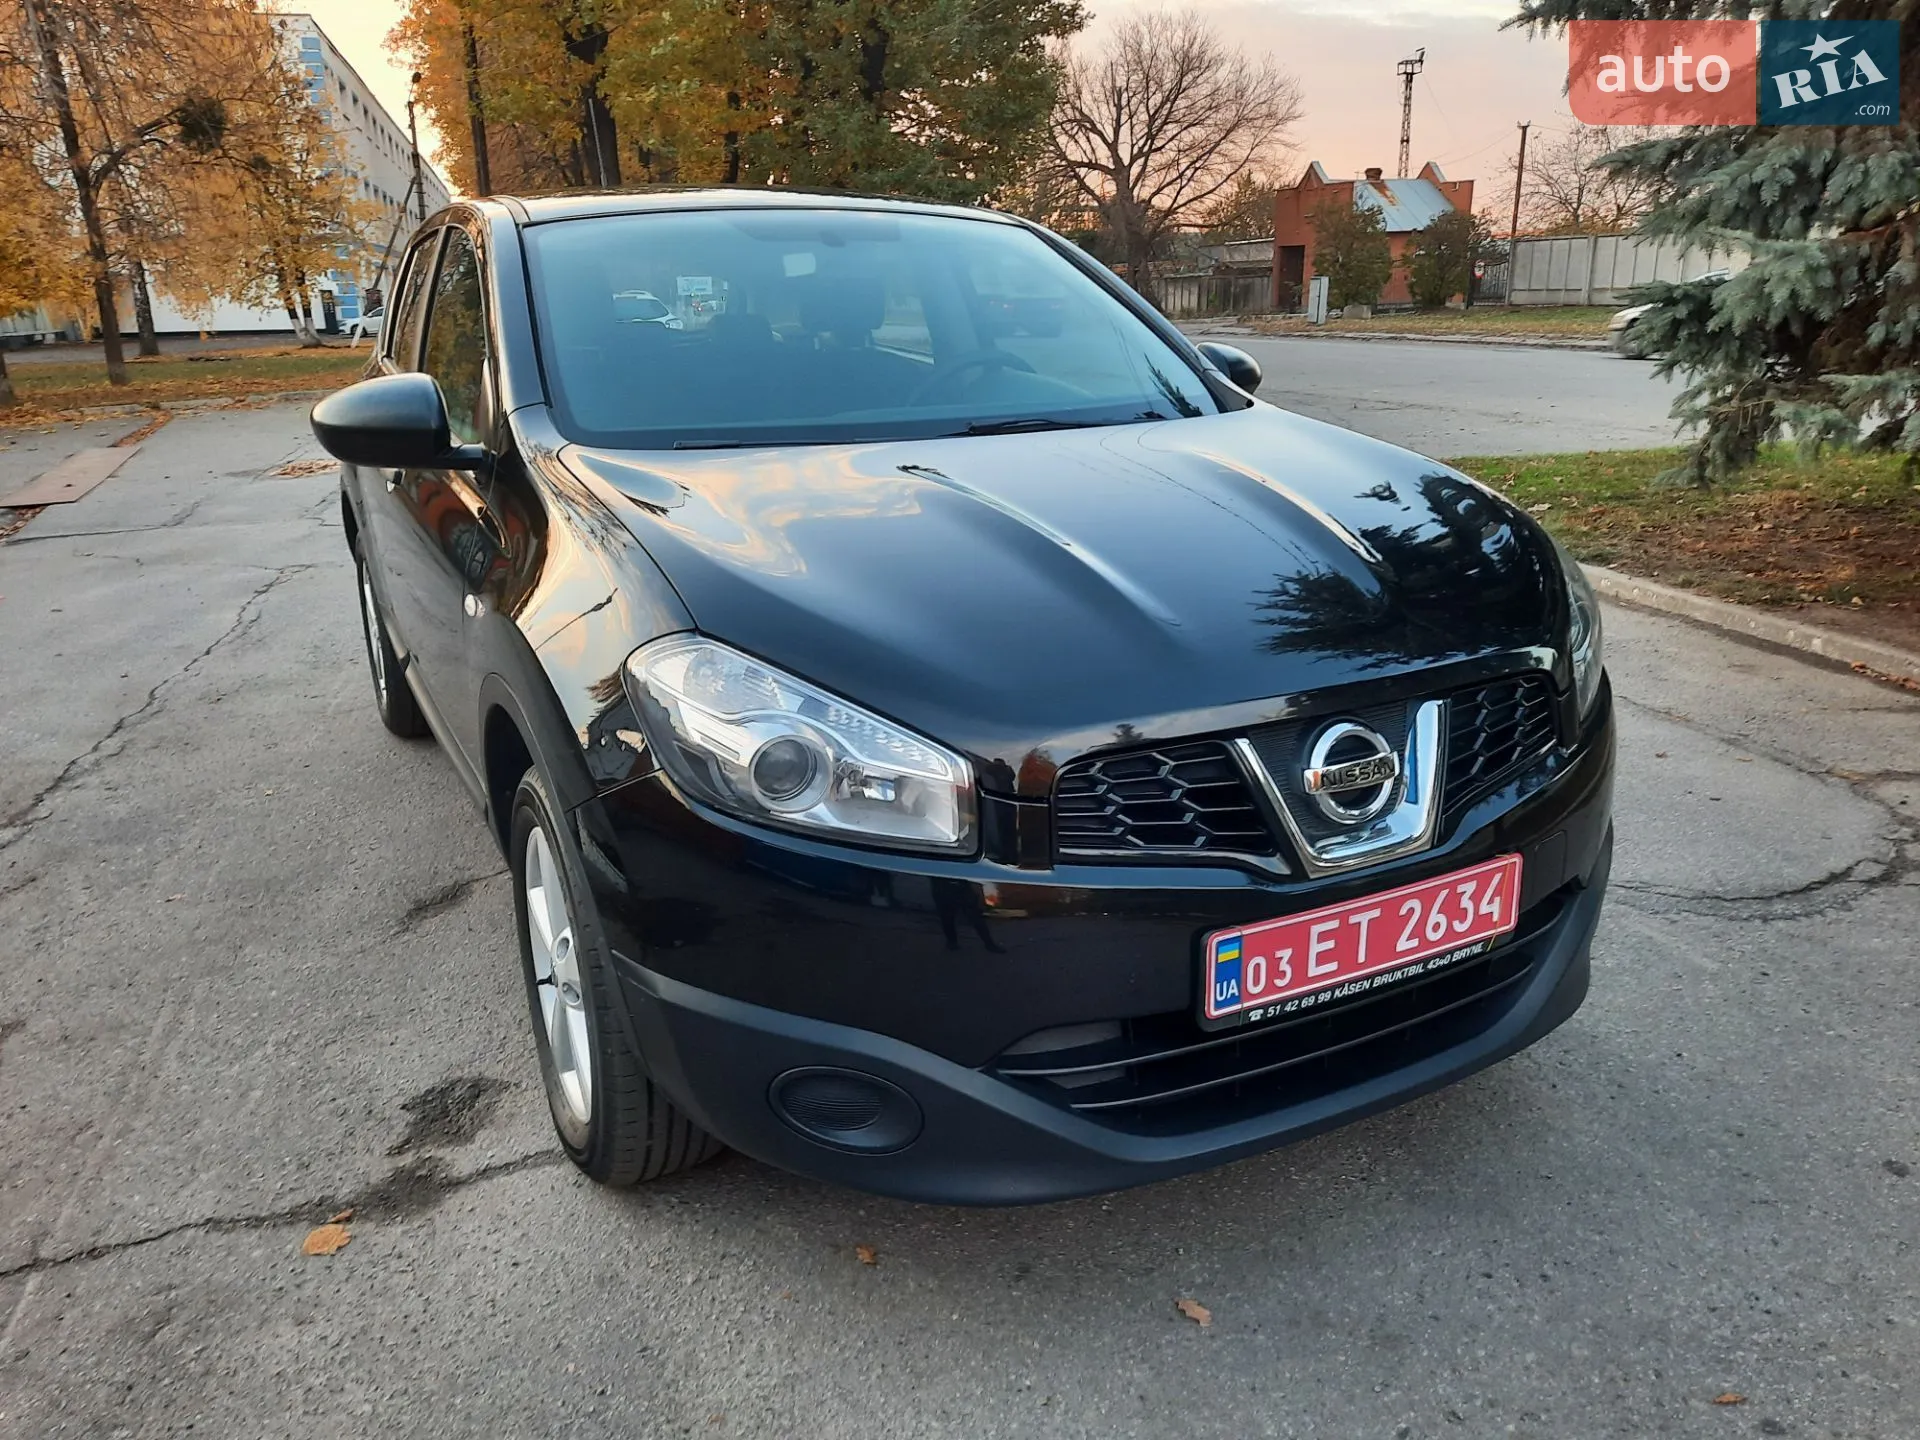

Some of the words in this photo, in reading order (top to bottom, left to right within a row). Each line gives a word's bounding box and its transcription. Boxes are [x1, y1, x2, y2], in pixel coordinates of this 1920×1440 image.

[1321, 761, 1395, 788] NISSAN
[1246, 948, 1293, 994] 03
[1307, 908, 1381, 978] ET
[1396, 872, 1503, 953] 2634
[1215, 979, 1240, 1002] UA
[1267, 1004, 1281, 1018] 51
[1284, 999, 1299, 1013] 42
[1301, 995, 1316, 1008] 69
[1317, 991, 1332, 1004] 99
[1334, 978, 1372, 999] KÅSEN
[1372, 962, 1425, 987] BRUKTBIL
[1452, 942, 1485, 962] BRYNE
